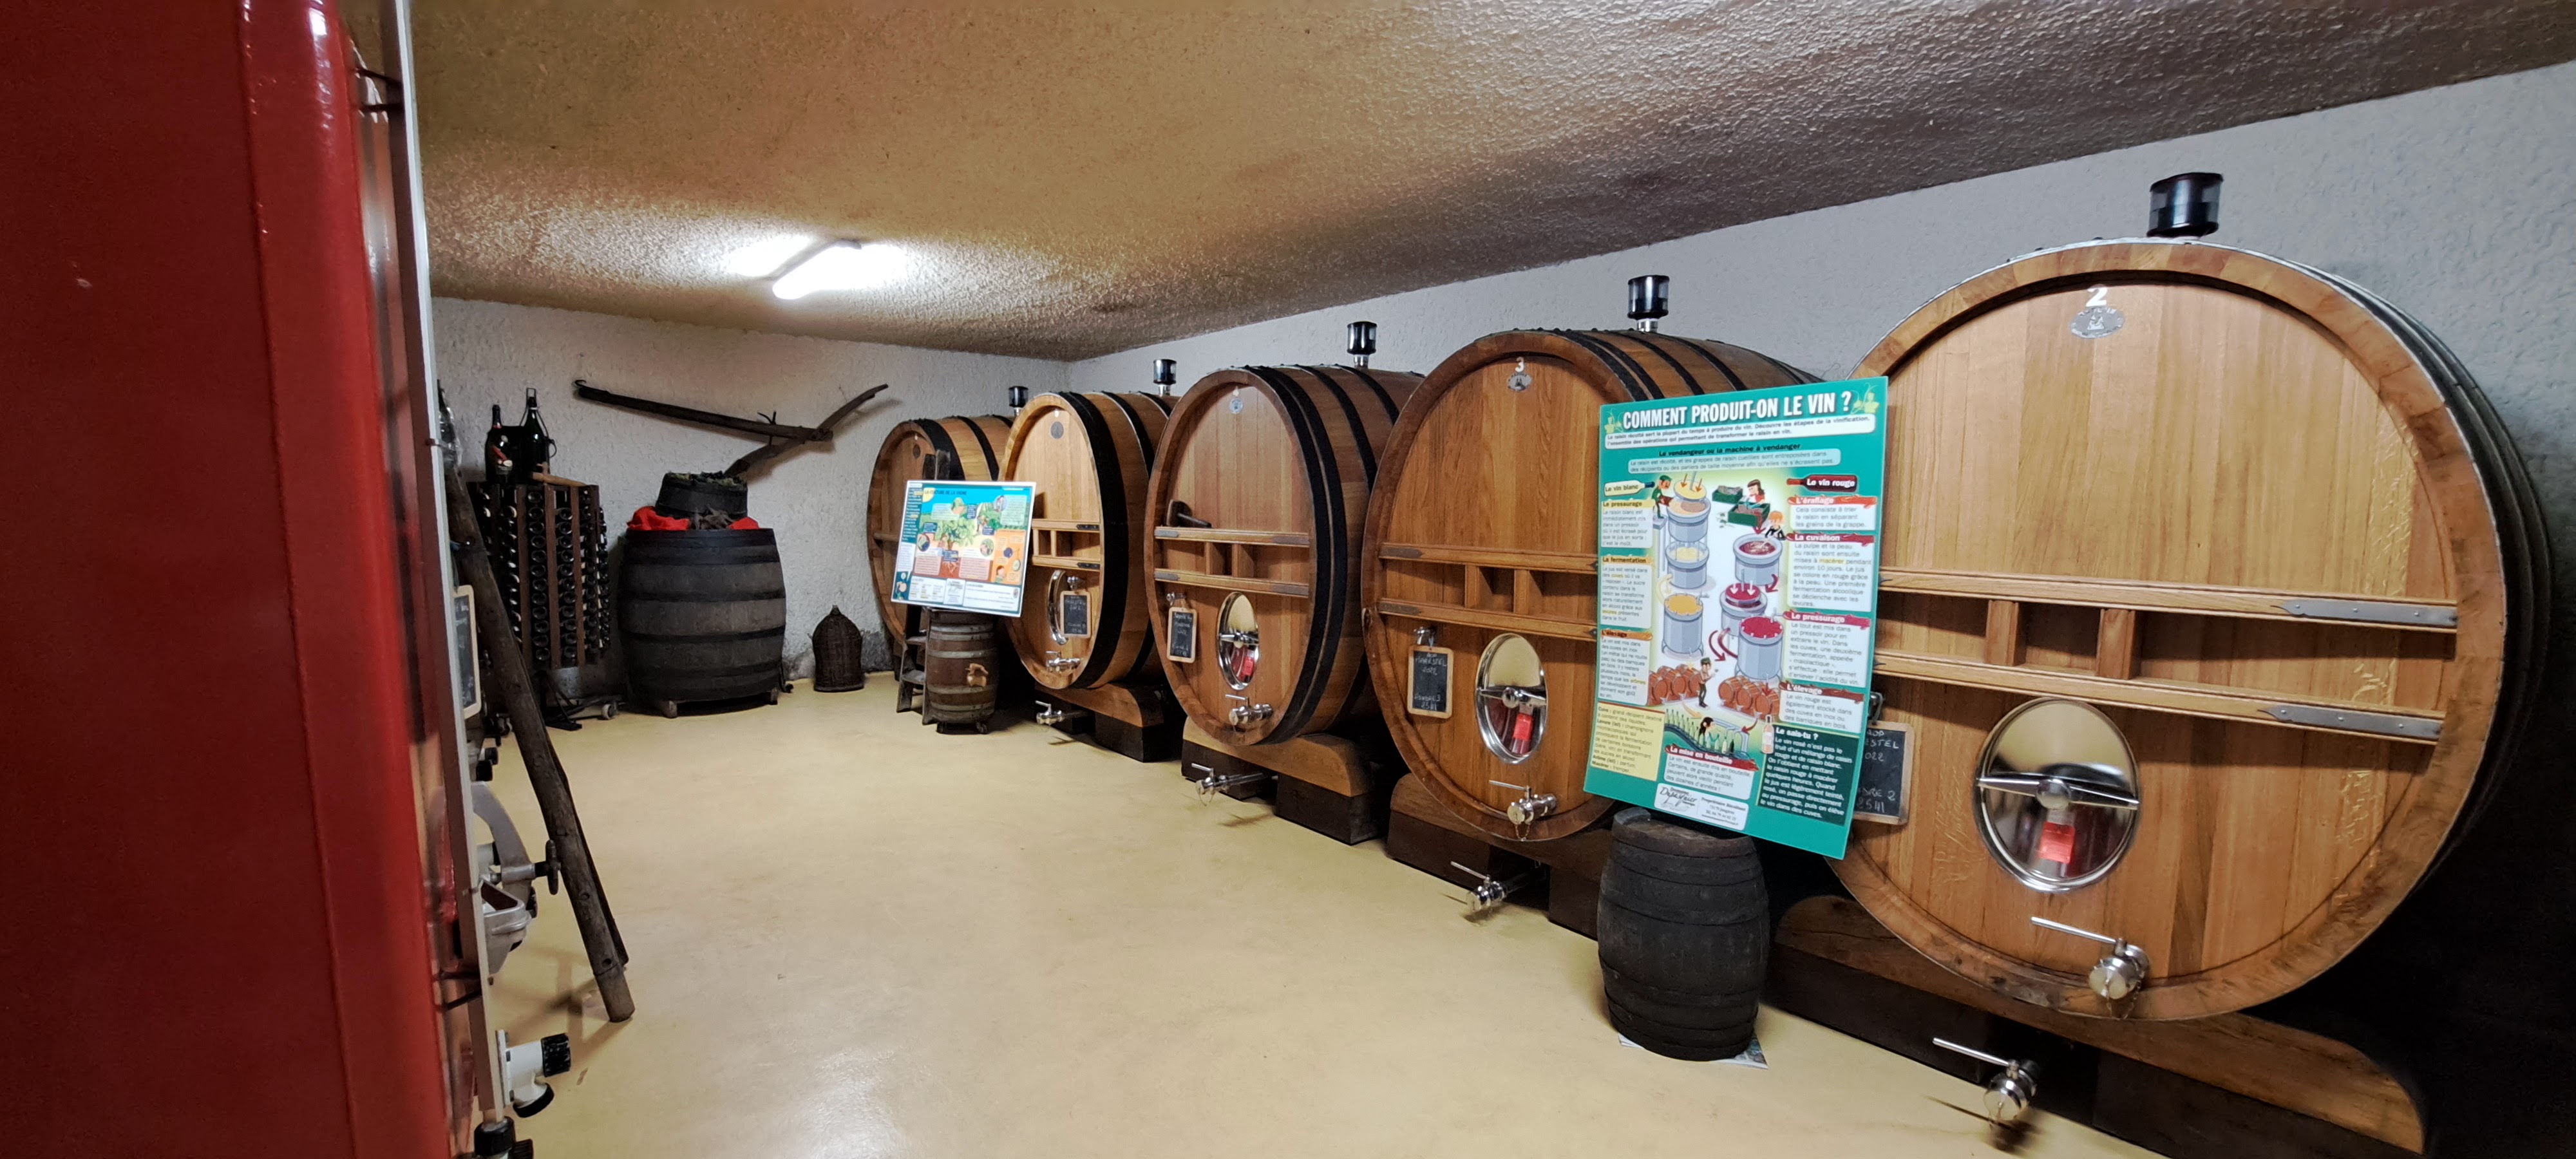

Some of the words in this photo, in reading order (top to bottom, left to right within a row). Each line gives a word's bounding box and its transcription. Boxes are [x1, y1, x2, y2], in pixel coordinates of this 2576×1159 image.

[2086, 284, 2108, 306] 2
[1515, 357, 1524, 372] 3
[1623, 407, 1687, 429] COMMENT
[1691, 398, 1778, 423] PRODUIT-ON
[1783, 395, 1803, 416] LE
[1807, 392, 1836, 413] VIN
[1841, 390, 1852, 411] ?
[1763, 443, 1801, 451] vendanger
[1832, 480, 1855, 488] rouge
[1803, 614, 1845, 624] pressurage
[1786, 684, 1823, 696] L'élevage
[1776, 726, 1785, 735] Le
[1786, 728, 1811, 739] sais-tu
[1678, 747, 1694, 757] mise
[1704, 753, 1733, 765] bouteille
[1888, 791, 1895, 800] 2
